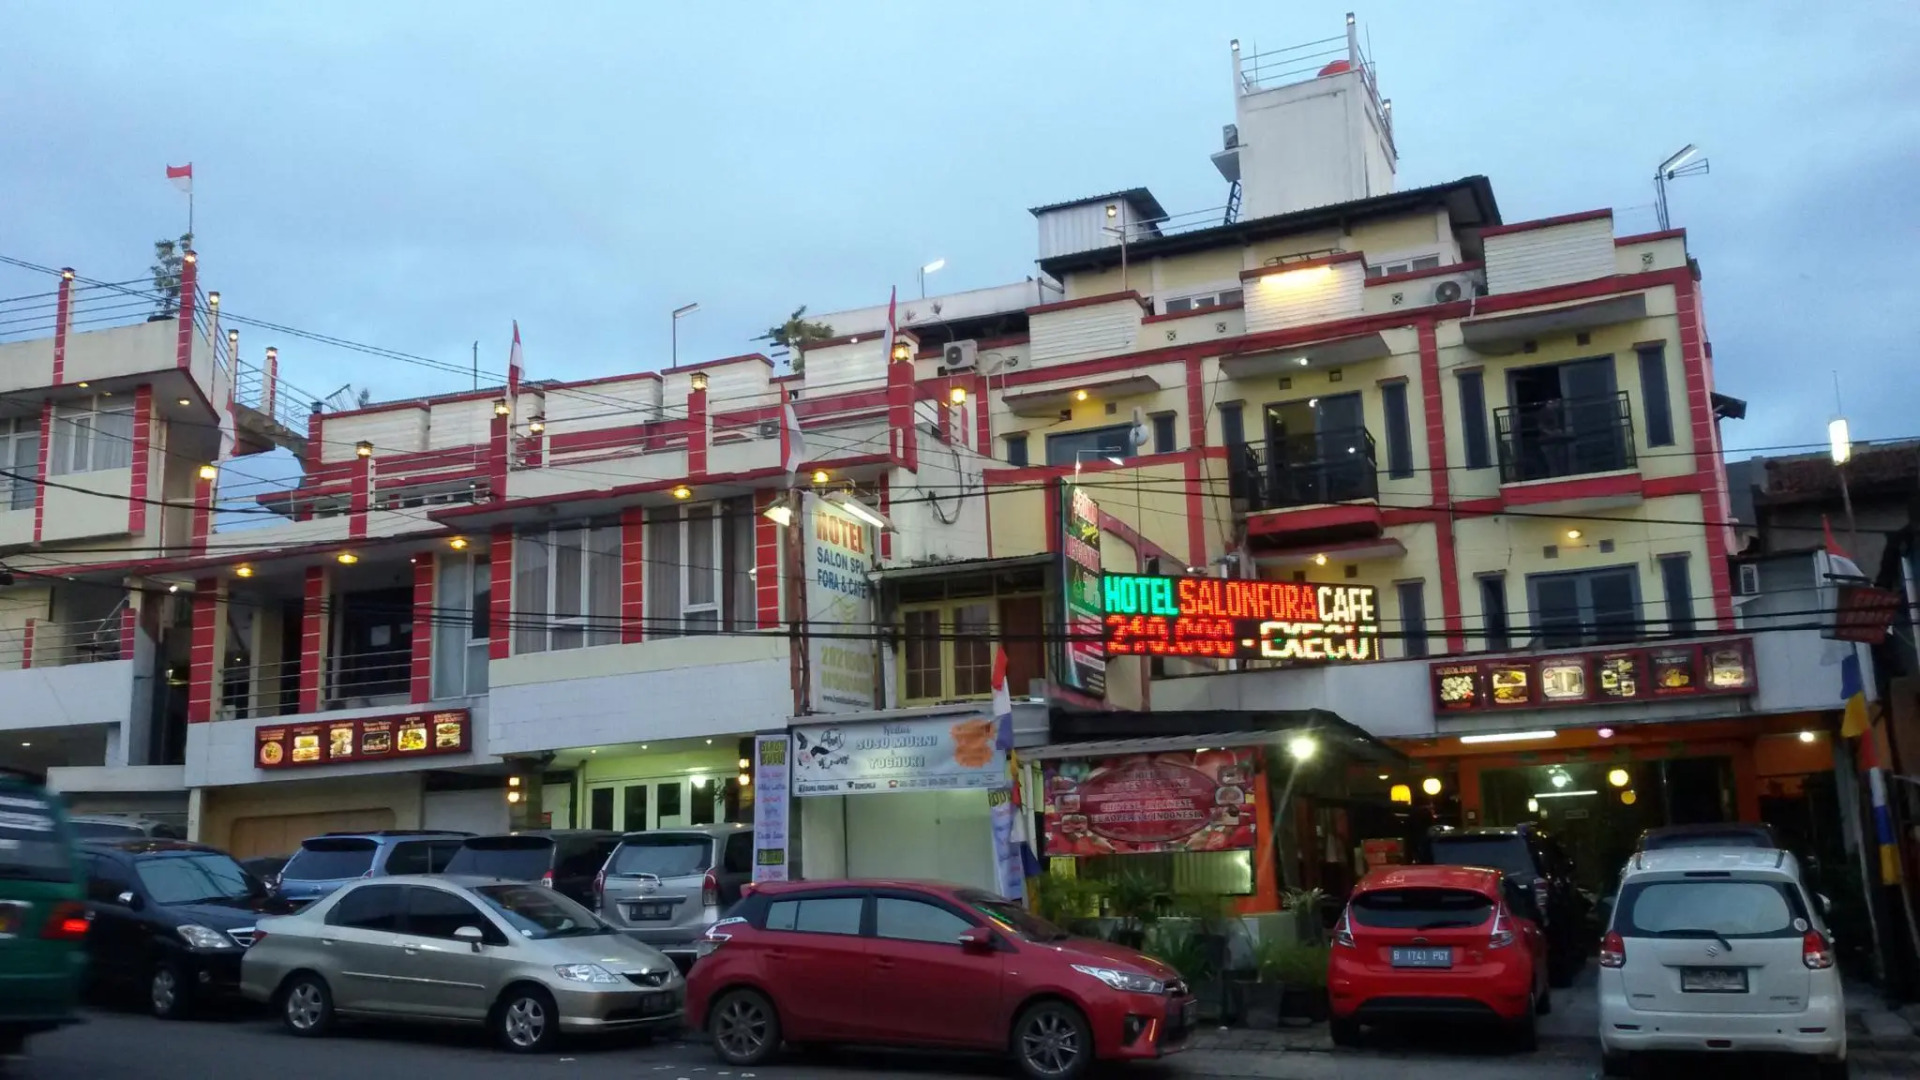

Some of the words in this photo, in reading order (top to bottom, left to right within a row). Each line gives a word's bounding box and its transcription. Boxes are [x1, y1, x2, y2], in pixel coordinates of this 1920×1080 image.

[816, 511, 864, 554] HOTEL
[816, 547, 848, 570] SALON
[849, 558, 866, 575] SPA
[817, 568, 839, 591] FORA
[841, 576, 847, 593] &
[848, 578, 866, 599] CAFE
[1104, 576, 1178, 615] HOTEL
[1178, 579, 1318, 620] SALONFORA
[1317, 586, 1374, 622] CAFE
[856, 736, 889, 750] SUSU
[892, 735, 938, 748] MURNI
